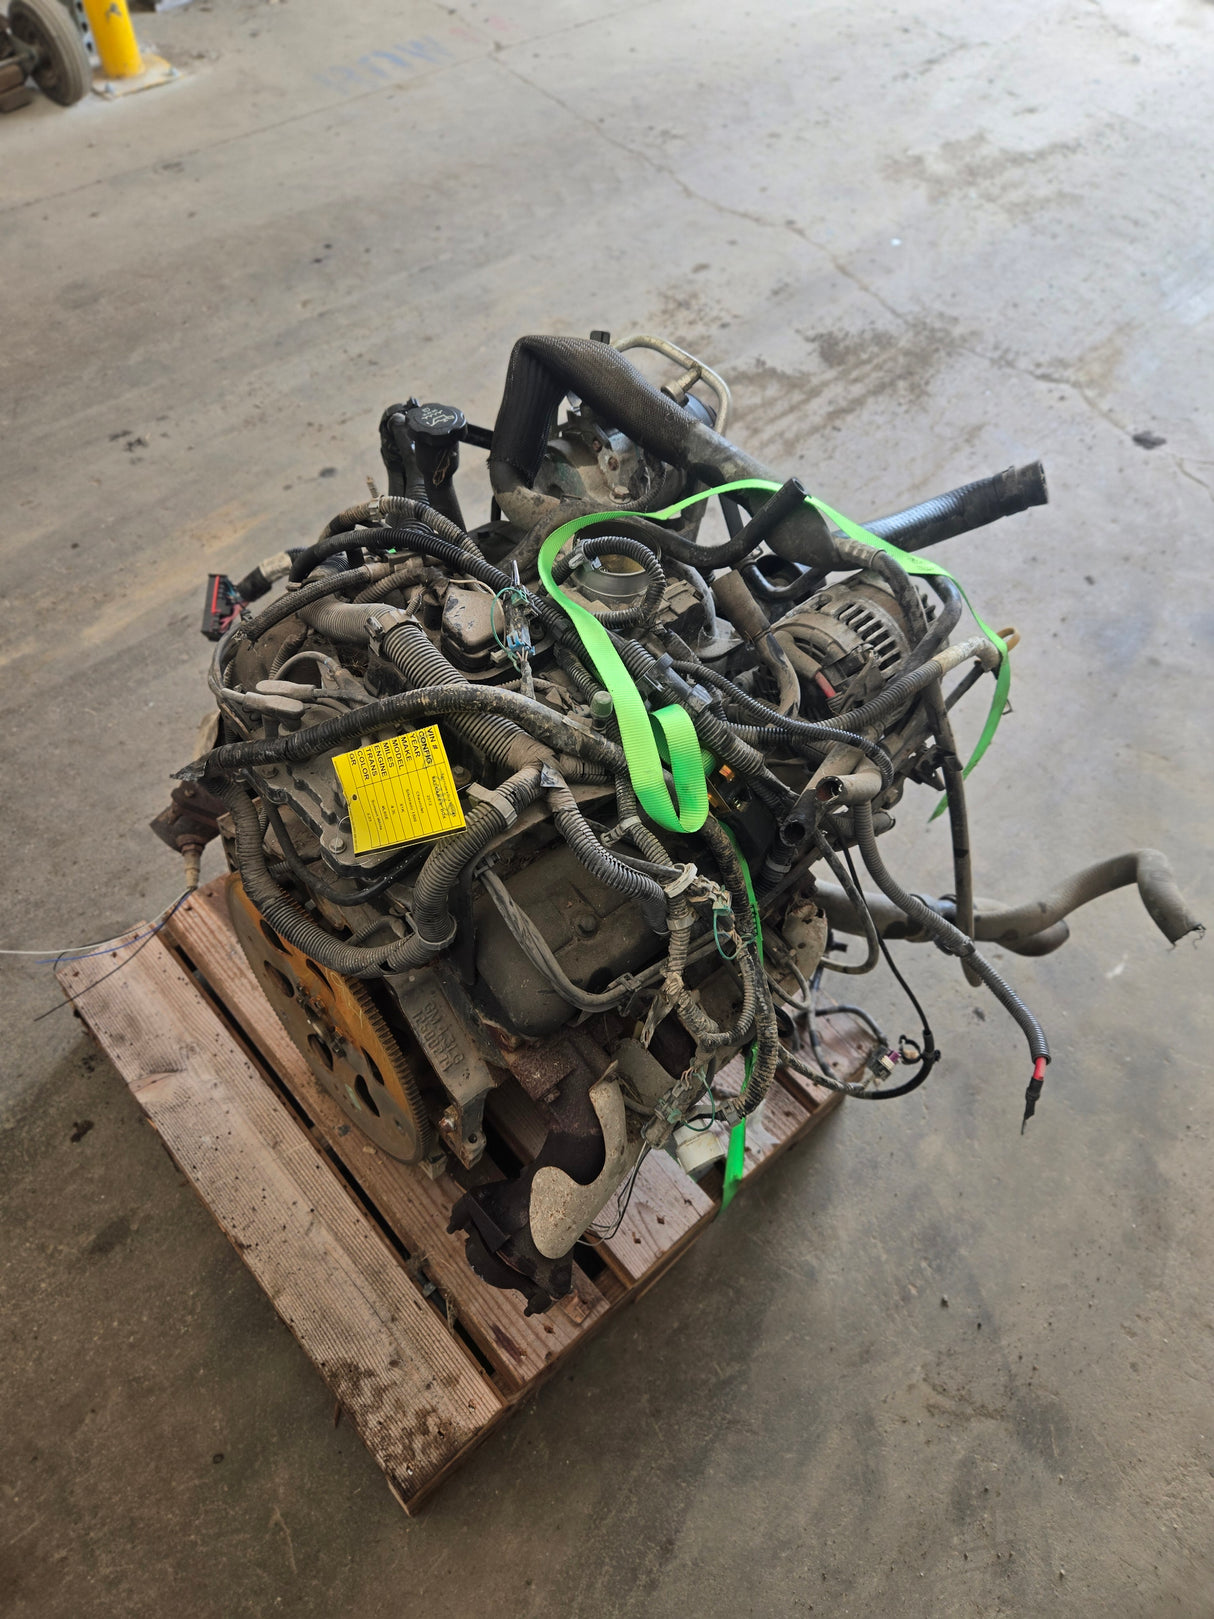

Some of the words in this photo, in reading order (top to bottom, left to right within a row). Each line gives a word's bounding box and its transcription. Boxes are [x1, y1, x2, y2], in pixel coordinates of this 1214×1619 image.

[400, 735, 412, 761] MAKE
[409, 732, 420, 757] YEAR
[418, 730, 432, 764] CONFIG
[427, 727, 435, 742] VIN
[349, 752, 356, 765] GR
[357, 749, 369, 780] COLOR
[365, 747, 377, 776] TRANS
[374, 744, 387, 777] ENGINE
[383, 741, 394, 768] MILES
[391, 738, 404, 770] MODEL
